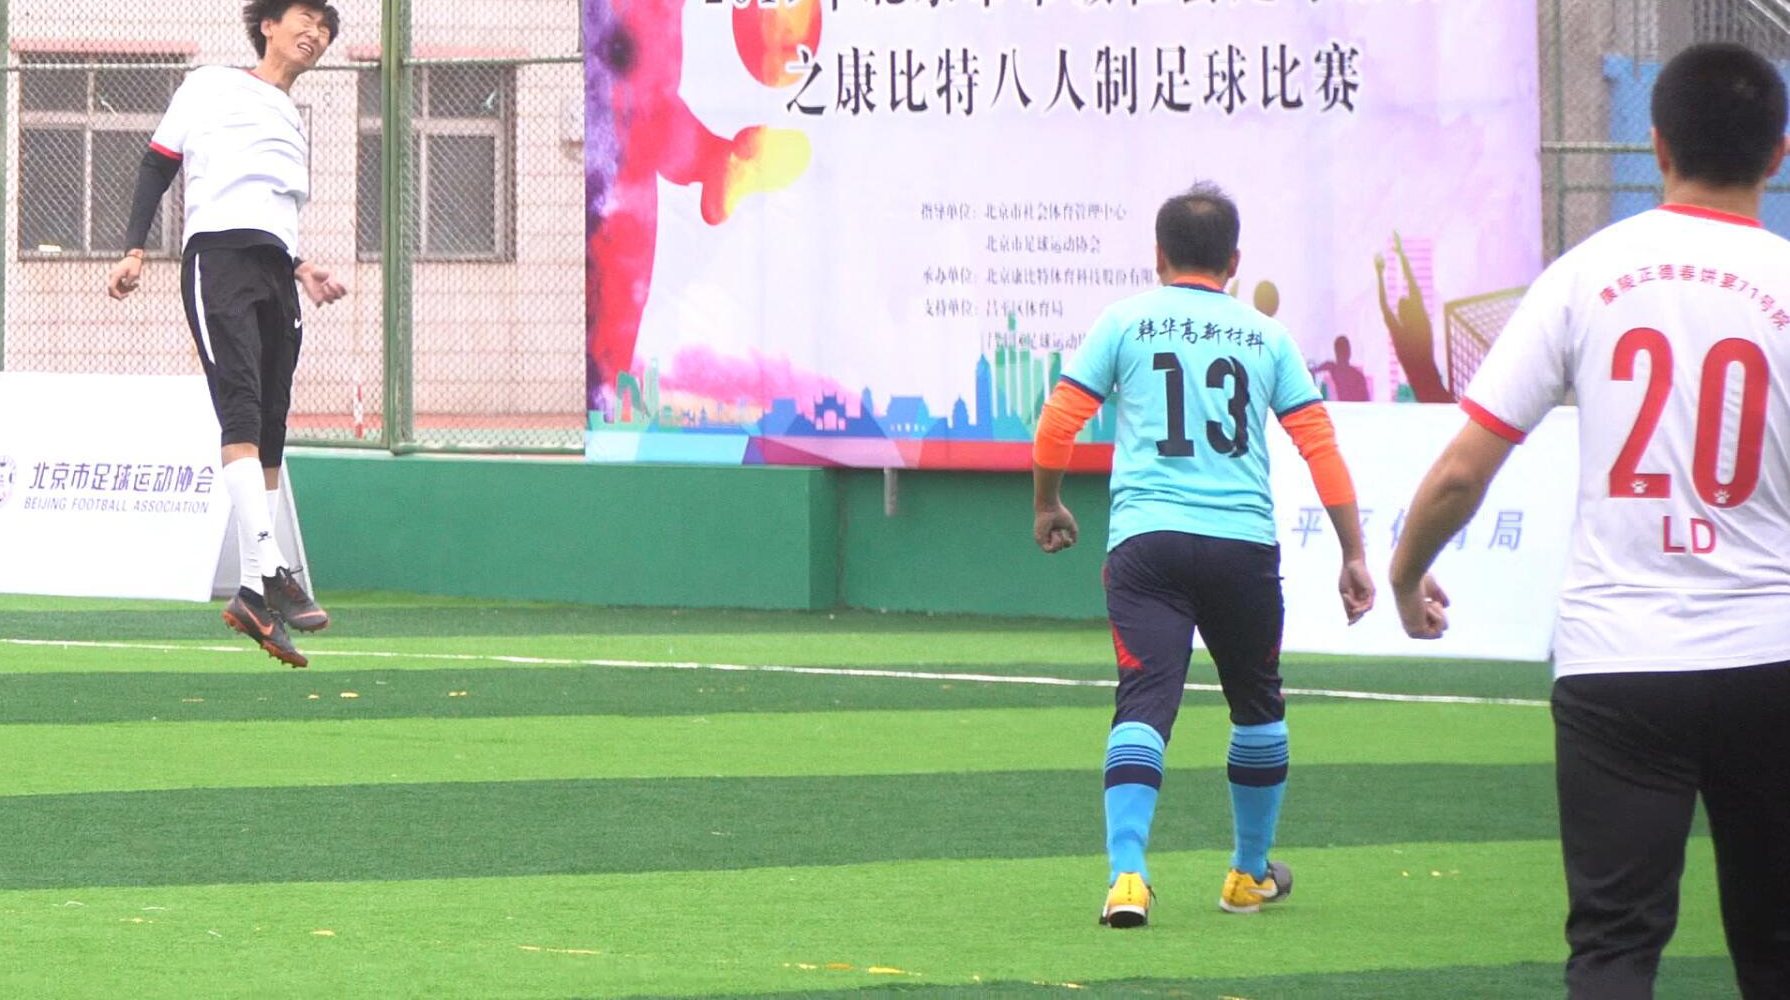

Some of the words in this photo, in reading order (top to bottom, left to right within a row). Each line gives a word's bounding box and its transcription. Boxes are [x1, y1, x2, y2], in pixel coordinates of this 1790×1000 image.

[786, 42, 1360, 117] 之康比特八人制足球比赛
[1135, 316, 1266, 357] 韩华高新材料
[1152, 351, 1251, 459] 13
[1608, 326, 1771, 510] 20
[28, 460, 215, 494] 北京市足球运动协会
[23, 496, 68, 512] BEIJING
[71, 498, 128, 513] FOOTBALL
[133, 500, 210, 514] ASSOCIATION
[1663, 515, 1718, 555] LD
